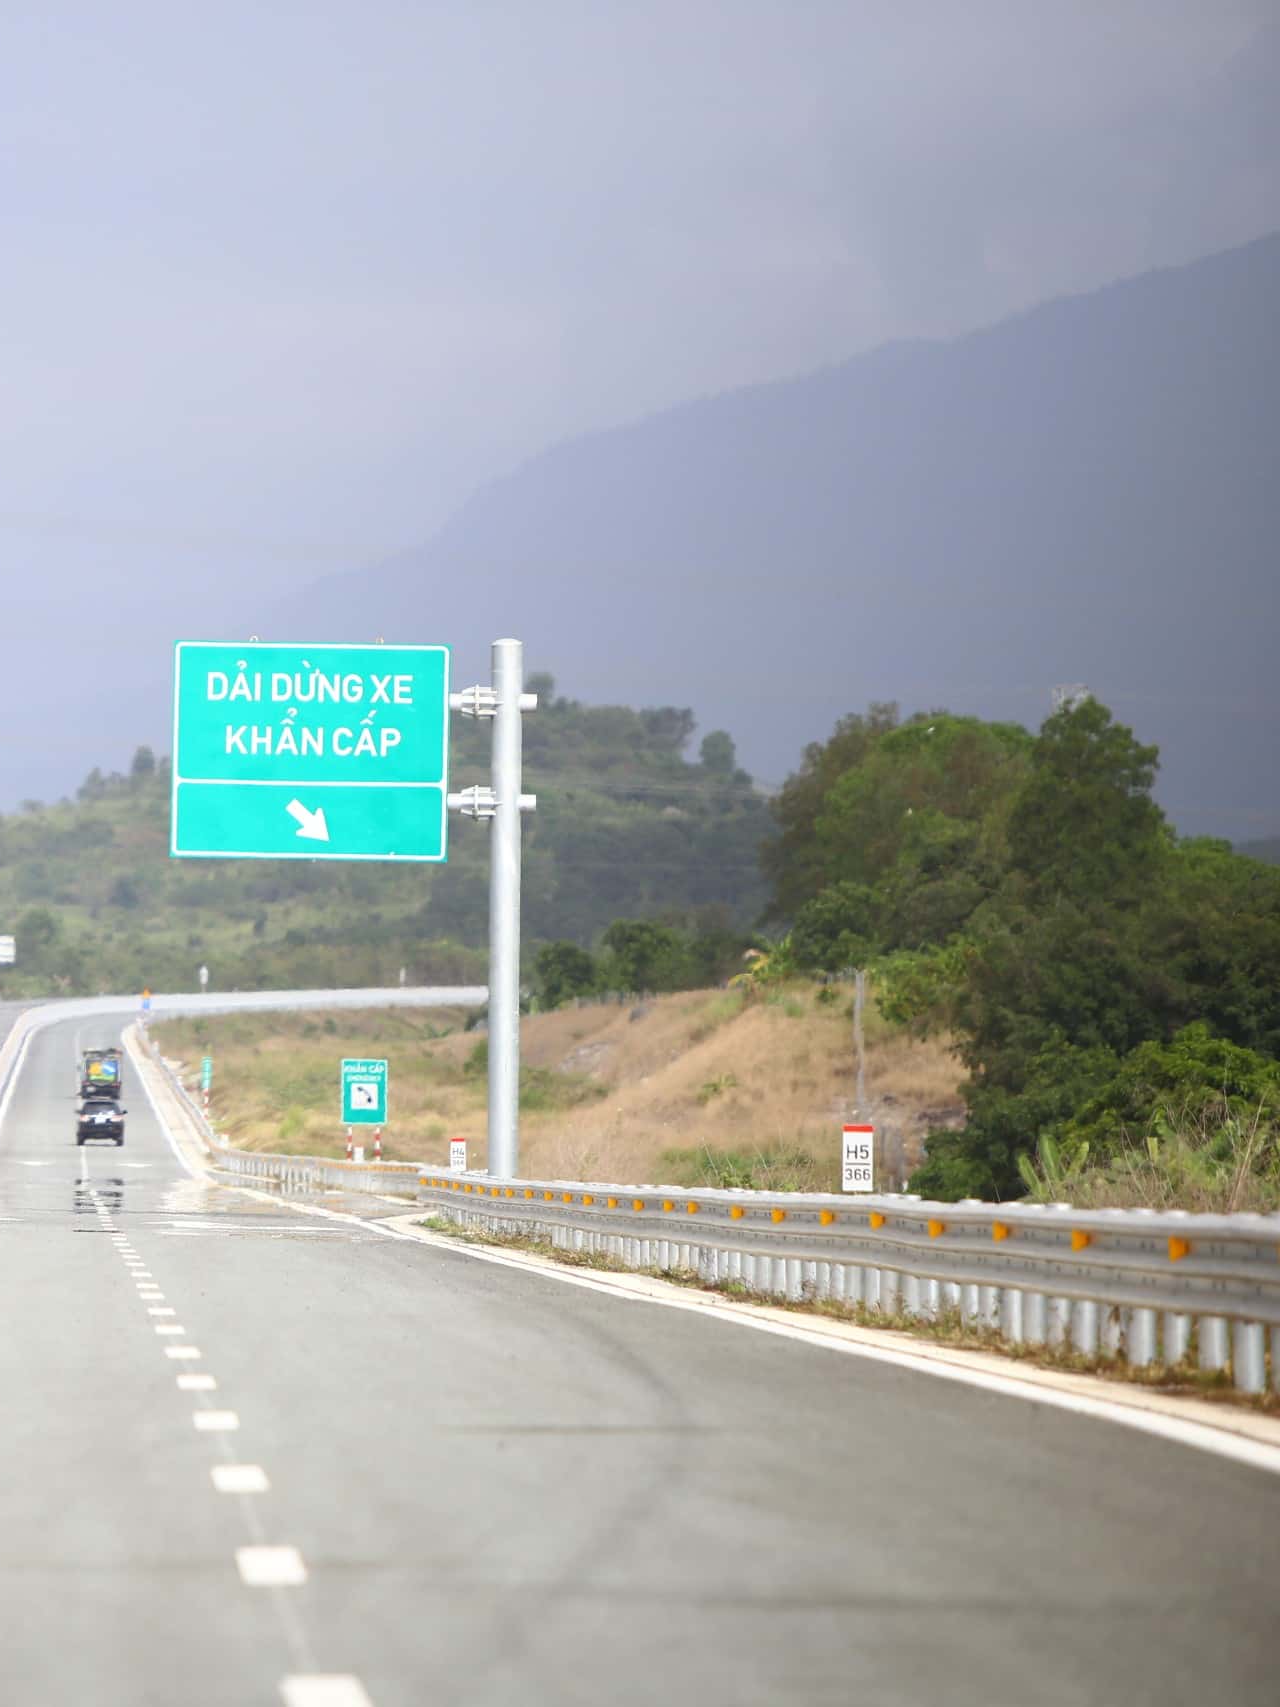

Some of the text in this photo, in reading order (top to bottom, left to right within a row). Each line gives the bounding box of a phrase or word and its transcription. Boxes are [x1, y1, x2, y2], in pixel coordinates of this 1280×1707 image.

[207, 659, 414, 705] DẢI DỪNG XE
[225, 707, 401, 757] KHẨN CẤP
[846, 1144, 869, 1160] H5
[845, 1168, 871, 1181] 366
